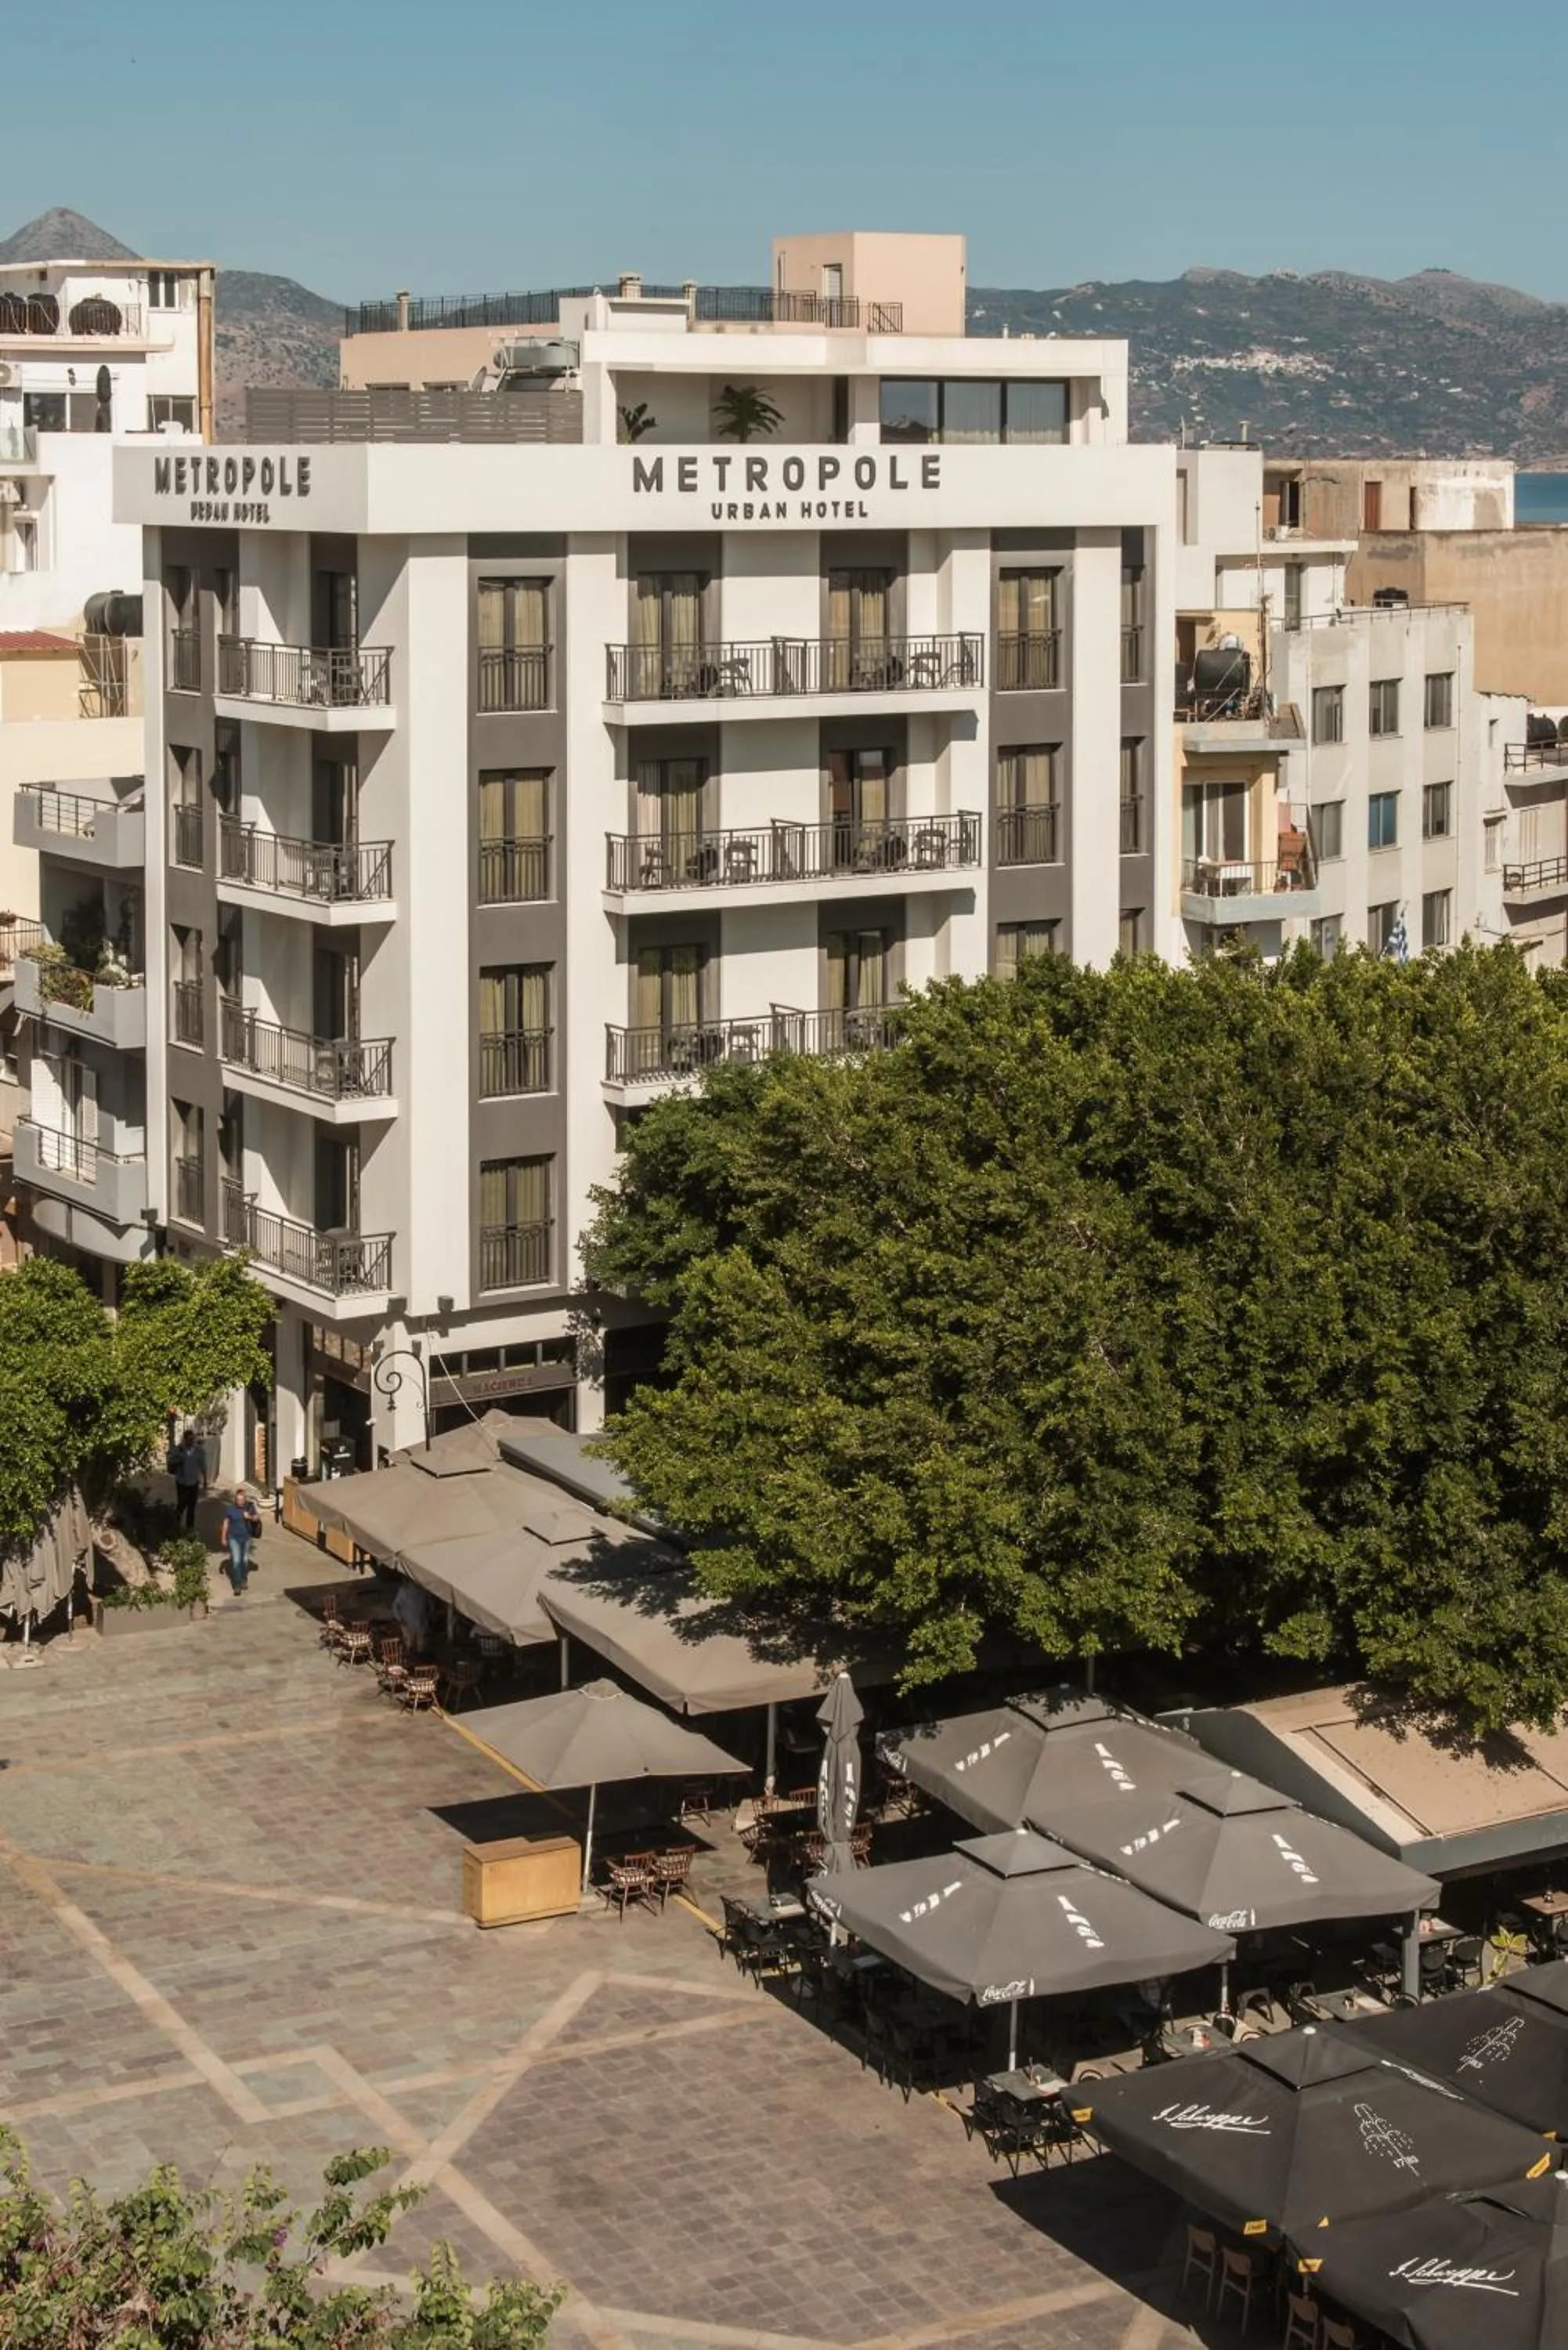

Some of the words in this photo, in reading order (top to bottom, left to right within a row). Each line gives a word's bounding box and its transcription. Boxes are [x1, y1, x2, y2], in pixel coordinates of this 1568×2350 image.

[154, 456, 311, 497] METROPOLE
[633, 454, 941, 492] METROPOLE
[190, 501, 229, 522] URBAN
[233, 502, 270, 524] HOTEL
[711, 502, 787, 519] URBAN
[801, 501, 869, 519] HOTEL
